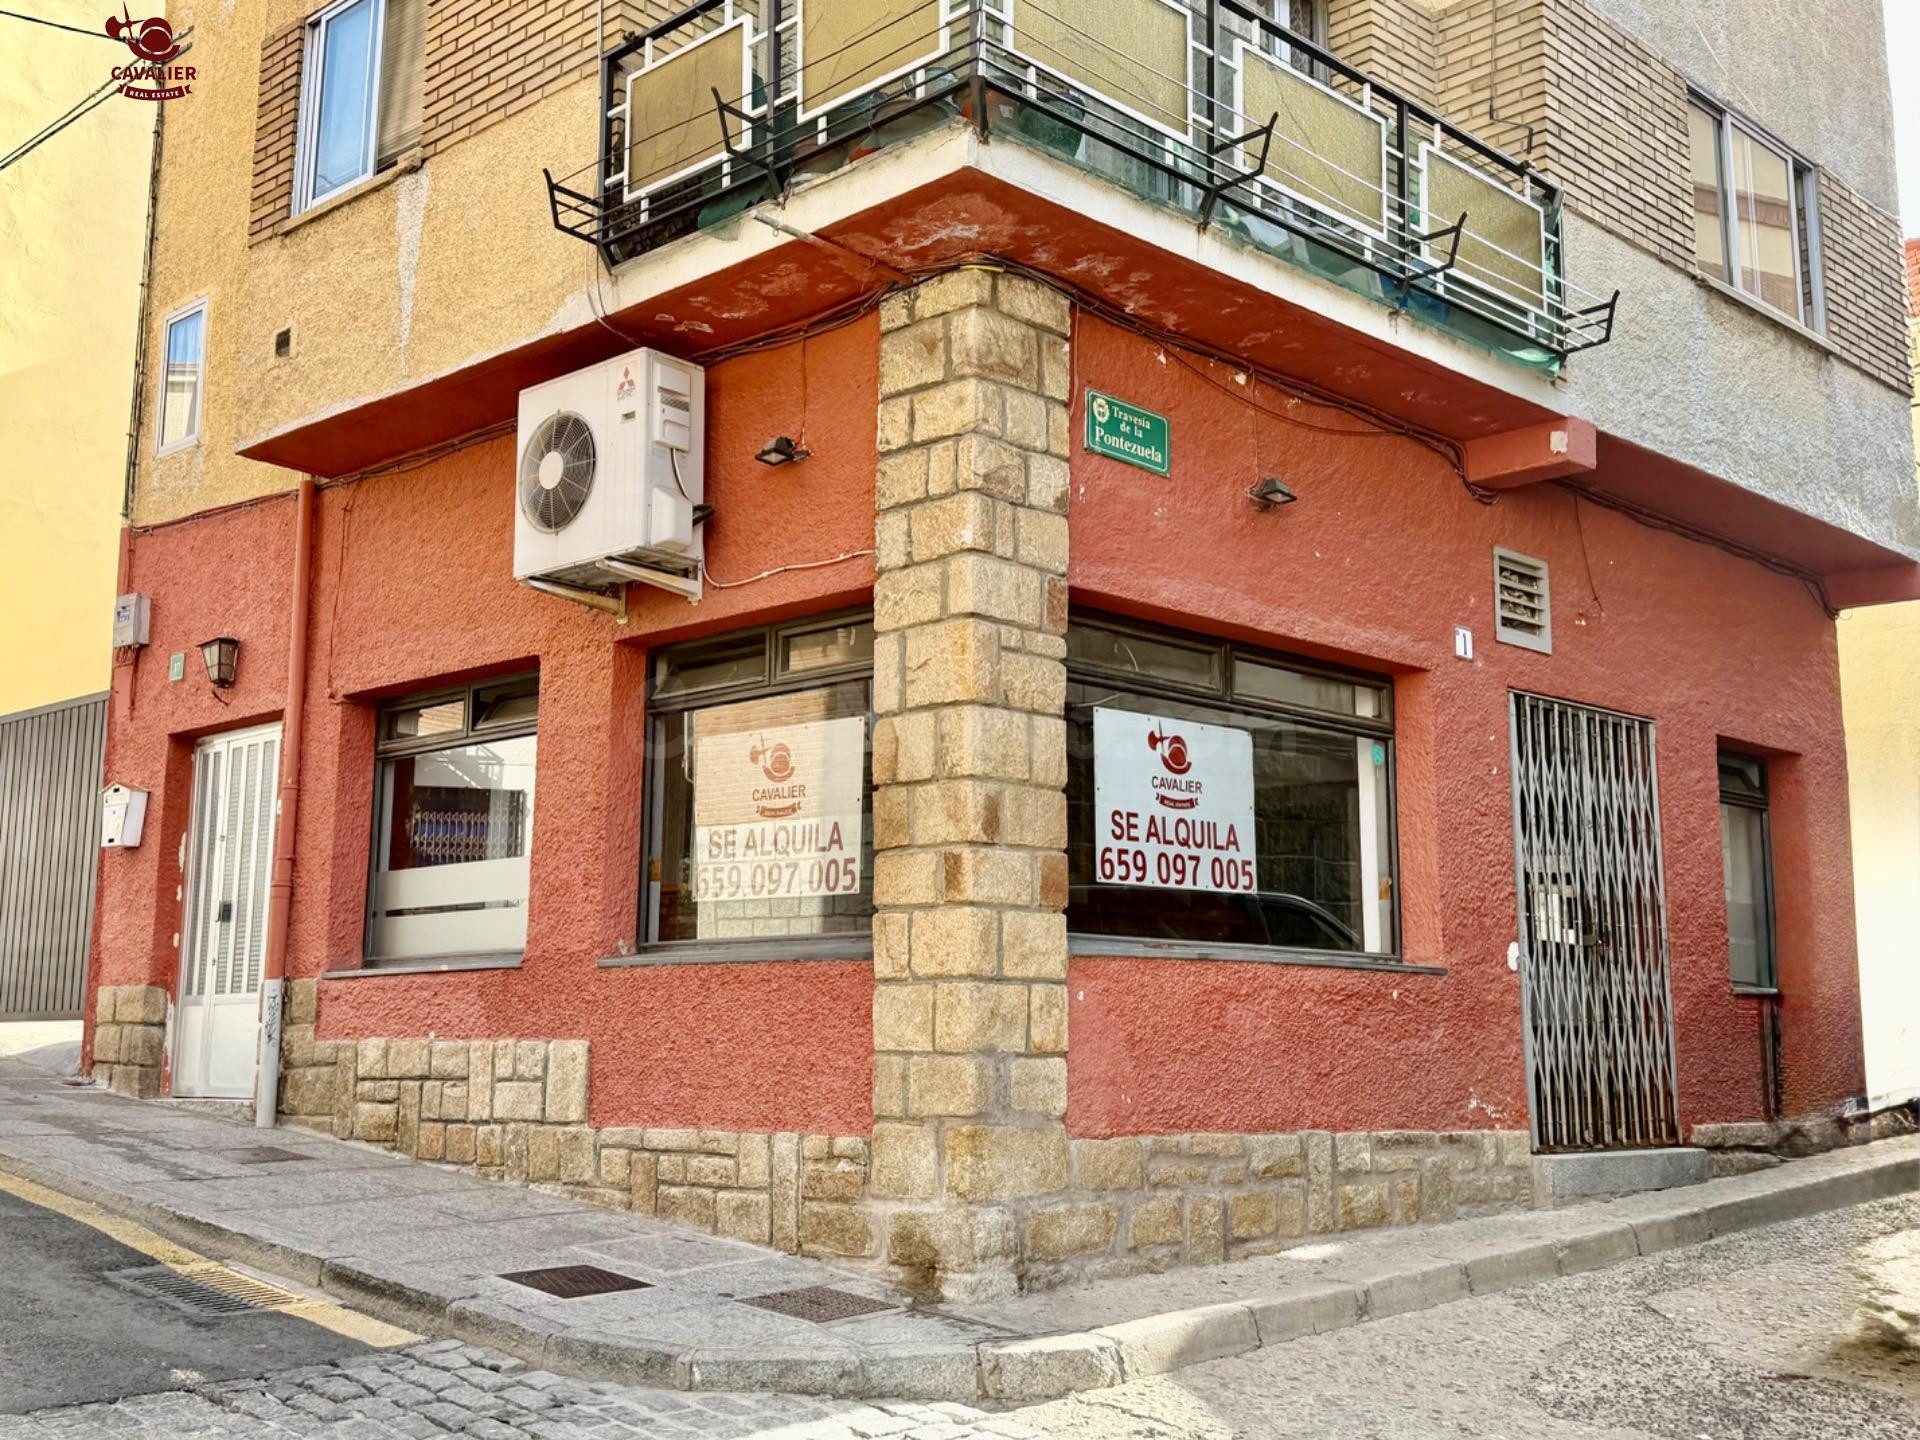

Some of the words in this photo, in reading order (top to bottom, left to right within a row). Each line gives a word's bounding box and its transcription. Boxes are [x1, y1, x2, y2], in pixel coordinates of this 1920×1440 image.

[1095, 425, 1162, 463] Pontezuela
[1119, 421, 1130, 433] de
[1134, 427, 1143, 438] la
[1462, 633, 1467, 655] 1
[752, 784, 807, 802] CAVALIER
[1151, 776, 1203, 795] CAVALIER
[708, 828, 737, 860] SE
[743, 821, 843, 858] ALQUILA
[1111, 809, 1140, 842] SE
[1145, 815, 1240, 852] ALQUILA
[697, 863, 741, 898] 659
[750, 861, 799, 895] 097
[808, 857, 856, 893] 005
[1100, 847, 1147, 883] 659
[1157, 851, 1201, 886] 097
[1211, 856, 1254, 891] 005
